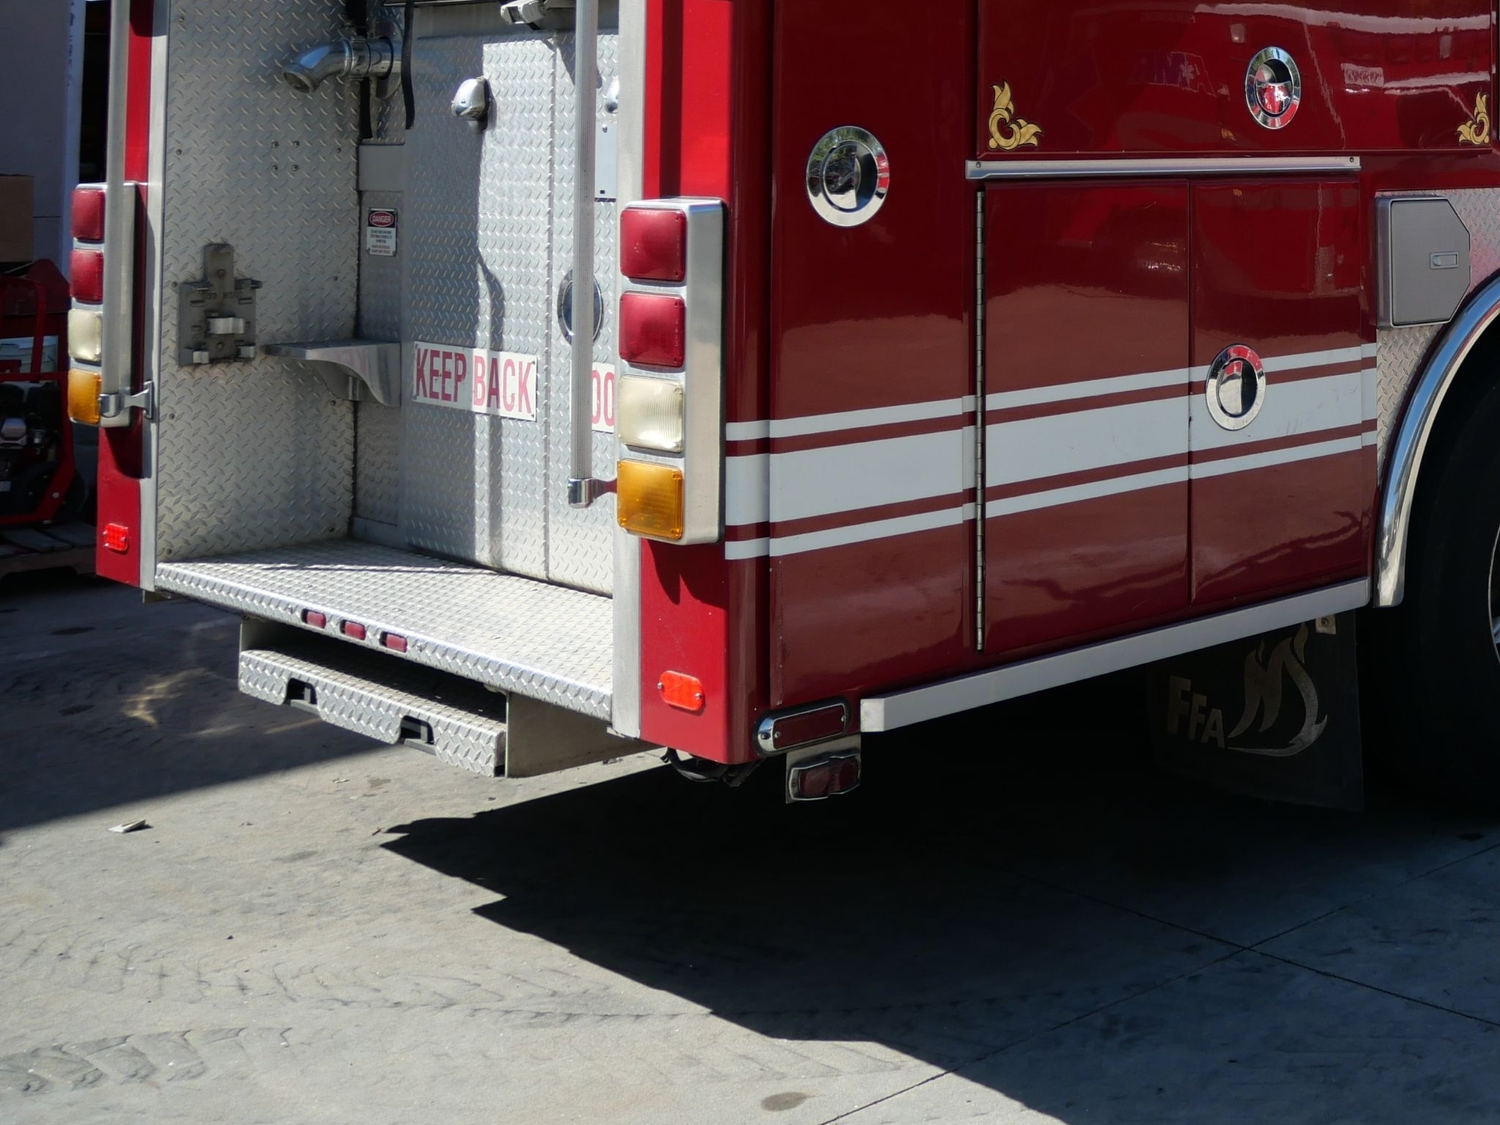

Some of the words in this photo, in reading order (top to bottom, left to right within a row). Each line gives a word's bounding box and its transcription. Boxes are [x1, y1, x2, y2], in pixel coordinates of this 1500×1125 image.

[416, 347, 467, 403] KEEP
[472, 355, 533, 415] BACK
[1167, 675, 1226, 749] FFA
